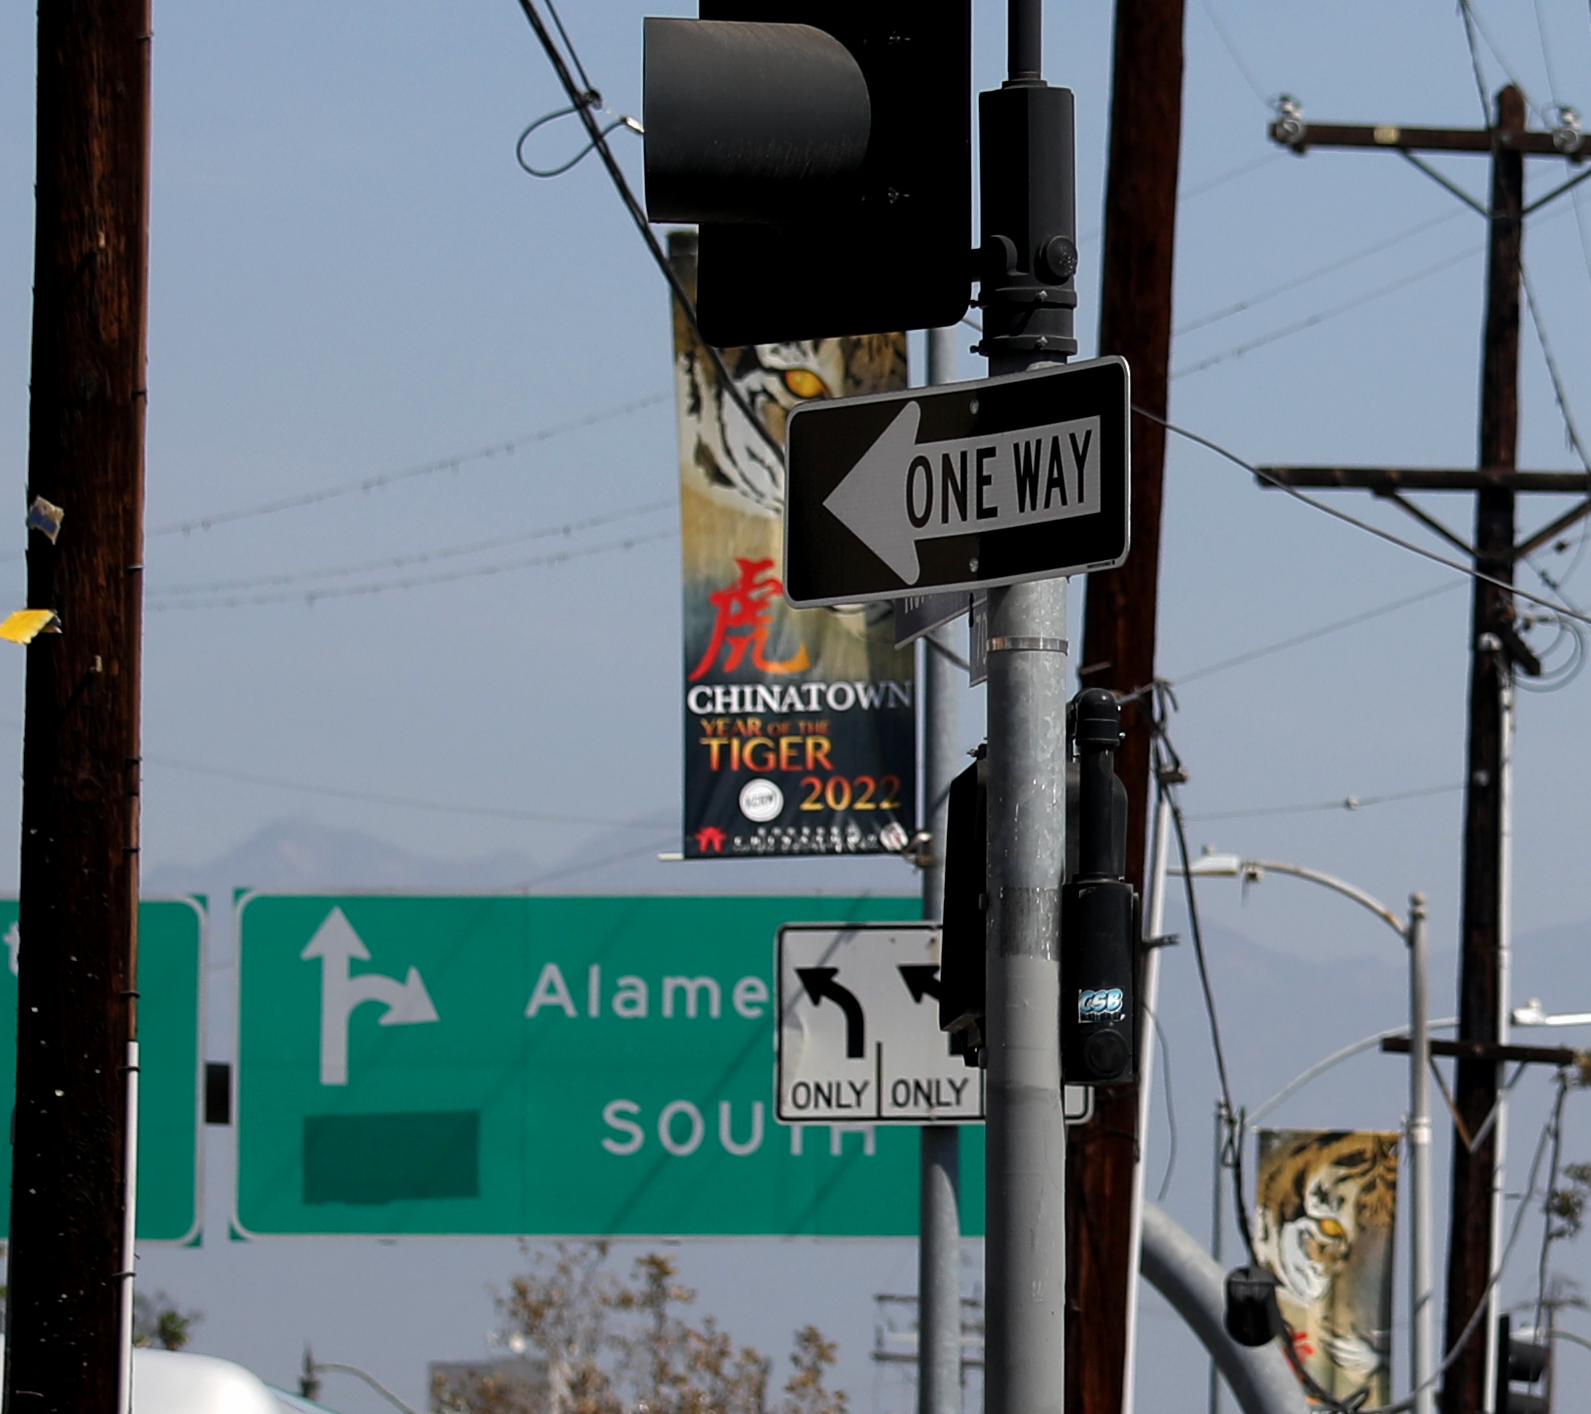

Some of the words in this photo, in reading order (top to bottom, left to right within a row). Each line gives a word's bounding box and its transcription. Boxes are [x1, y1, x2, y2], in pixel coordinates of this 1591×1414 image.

[904, 445, 999, 531] ONE
[1012, 428, 1095, 516] WAY
[687, 682, 913, 715] CHINATOWN
[700, 717, 763, 736] YEAR
[699, 737, 834, 772] TIGER
[799, 775, 903, 811] 2022
[525, 962, 770, 1018] Alame
[1079, 988, 1123, 1014] CSB
[791, 1079, 870, 1110] ONLY
[890, 1076, 970, 1108] ONLY
